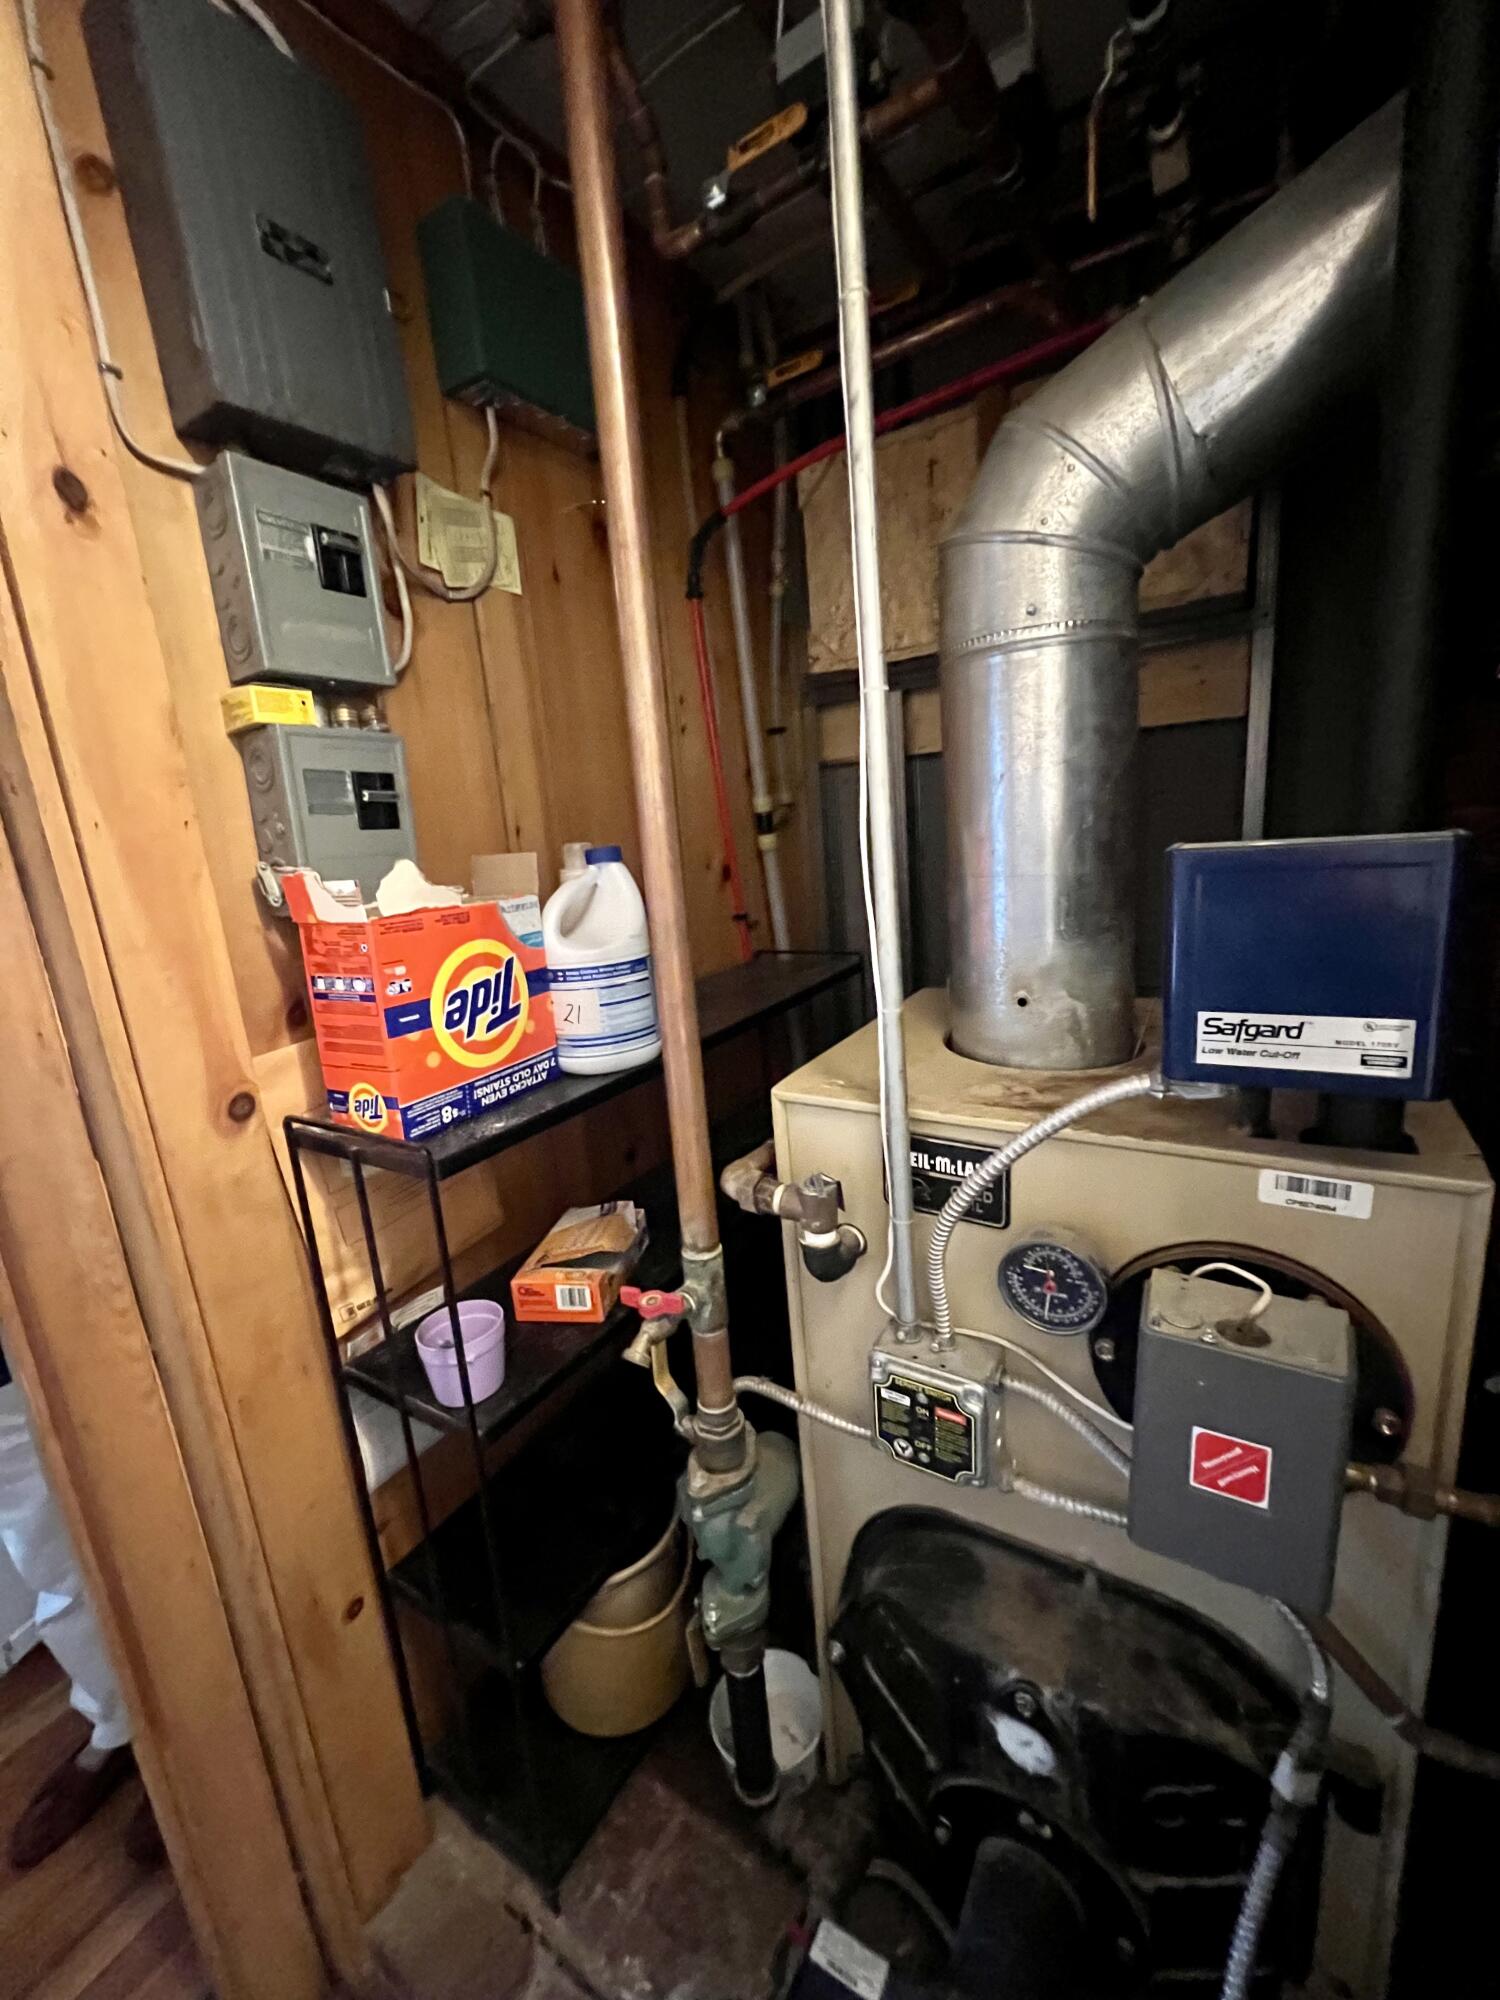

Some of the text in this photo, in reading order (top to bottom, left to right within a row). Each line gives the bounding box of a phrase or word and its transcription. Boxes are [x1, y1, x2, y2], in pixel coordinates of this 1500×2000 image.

[444, 955, 522, 1040] Tide
[563, 1003, 581, 1025] 21
[1202, 1017, 1305, 1043] Safgard
[550, 1056, 557, 1068] 7
[1201, 1046, 1301, 1060] Low Water Cut-Off
[512, 1067, 532, 1082] OLD
[532, 1059, 550, 1077] DAY
[473, 1074, 511, 1100] STAINS!
[508, 1071, 548, 1091] ATTACKS
[354, 1094, 383, 1119] Tide
[481, 1086, 508, 1107] EVEN
